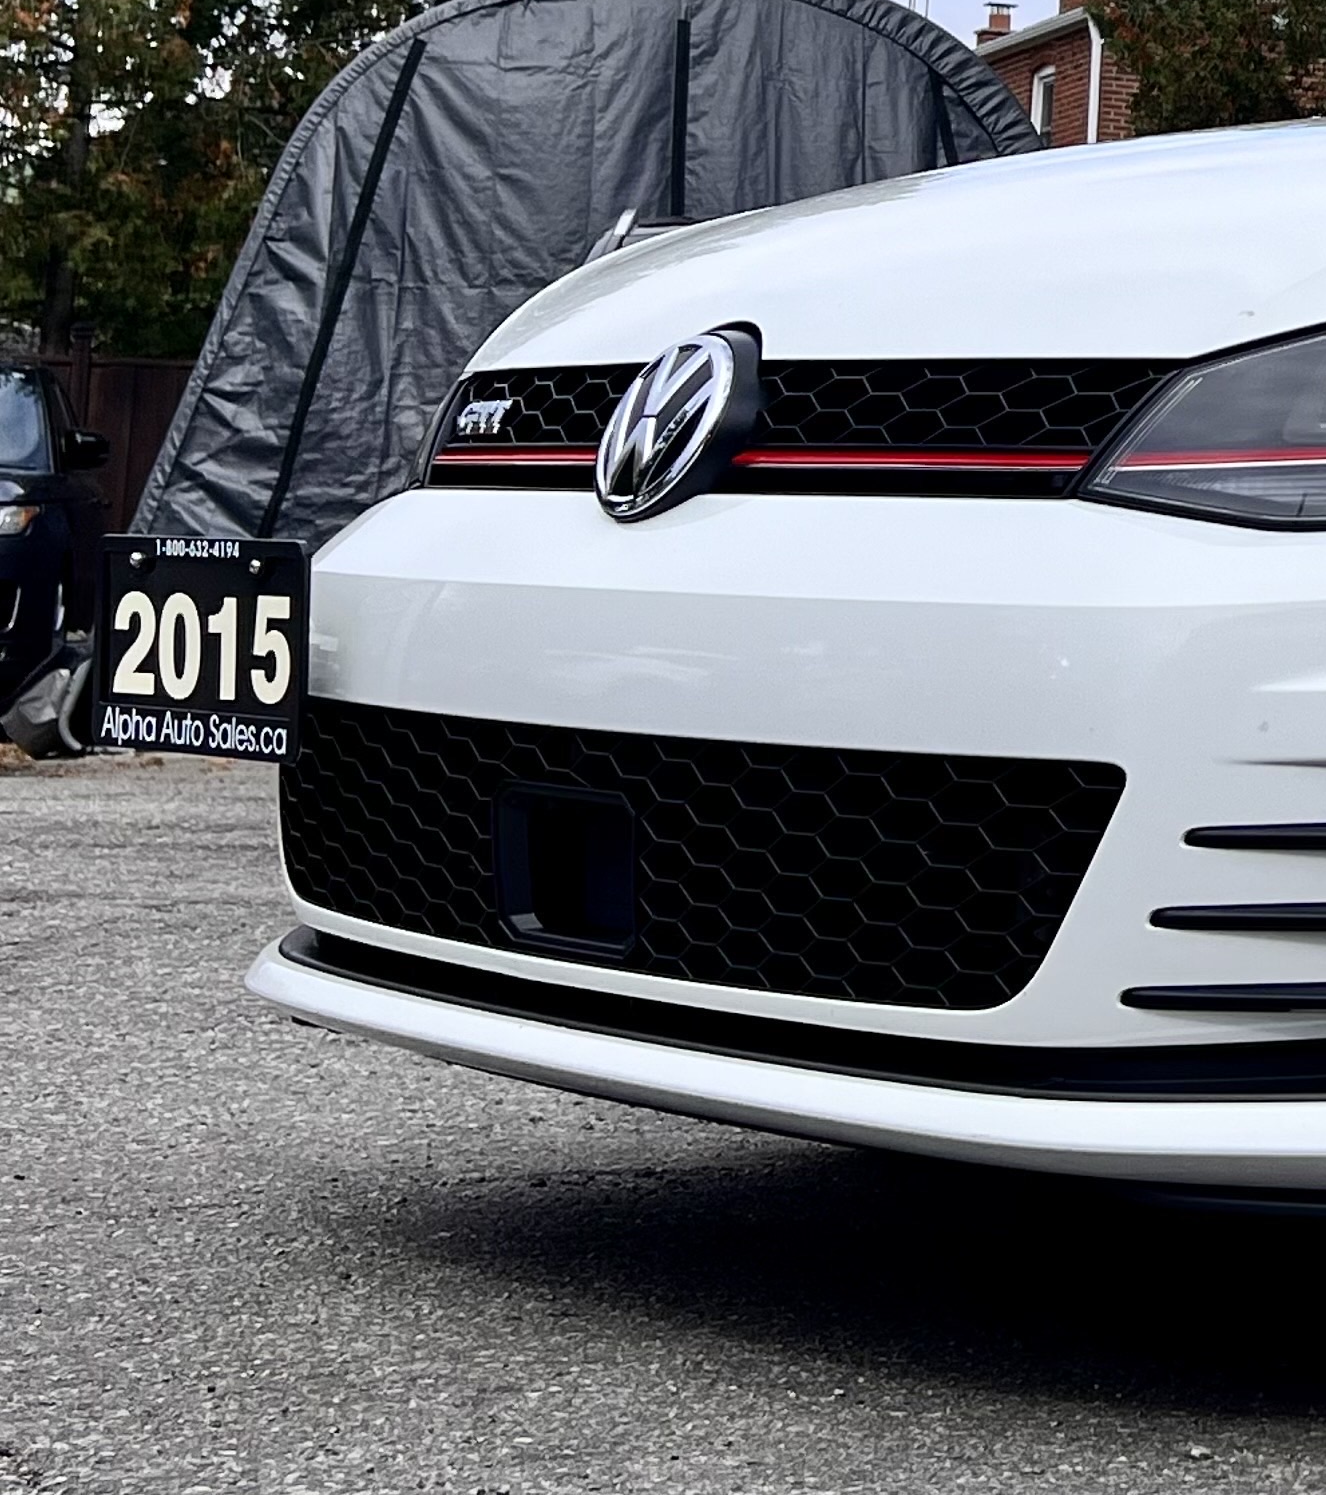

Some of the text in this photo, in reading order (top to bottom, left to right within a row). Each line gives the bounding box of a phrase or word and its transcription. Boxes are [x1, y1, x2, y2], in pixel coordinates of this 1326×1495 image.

[156, 538, 240, 559] 1-800-632-4194
[112, 590, 291, 705] 2015
[101, 706, 288, 755] Alpha Auto Sales.ca
